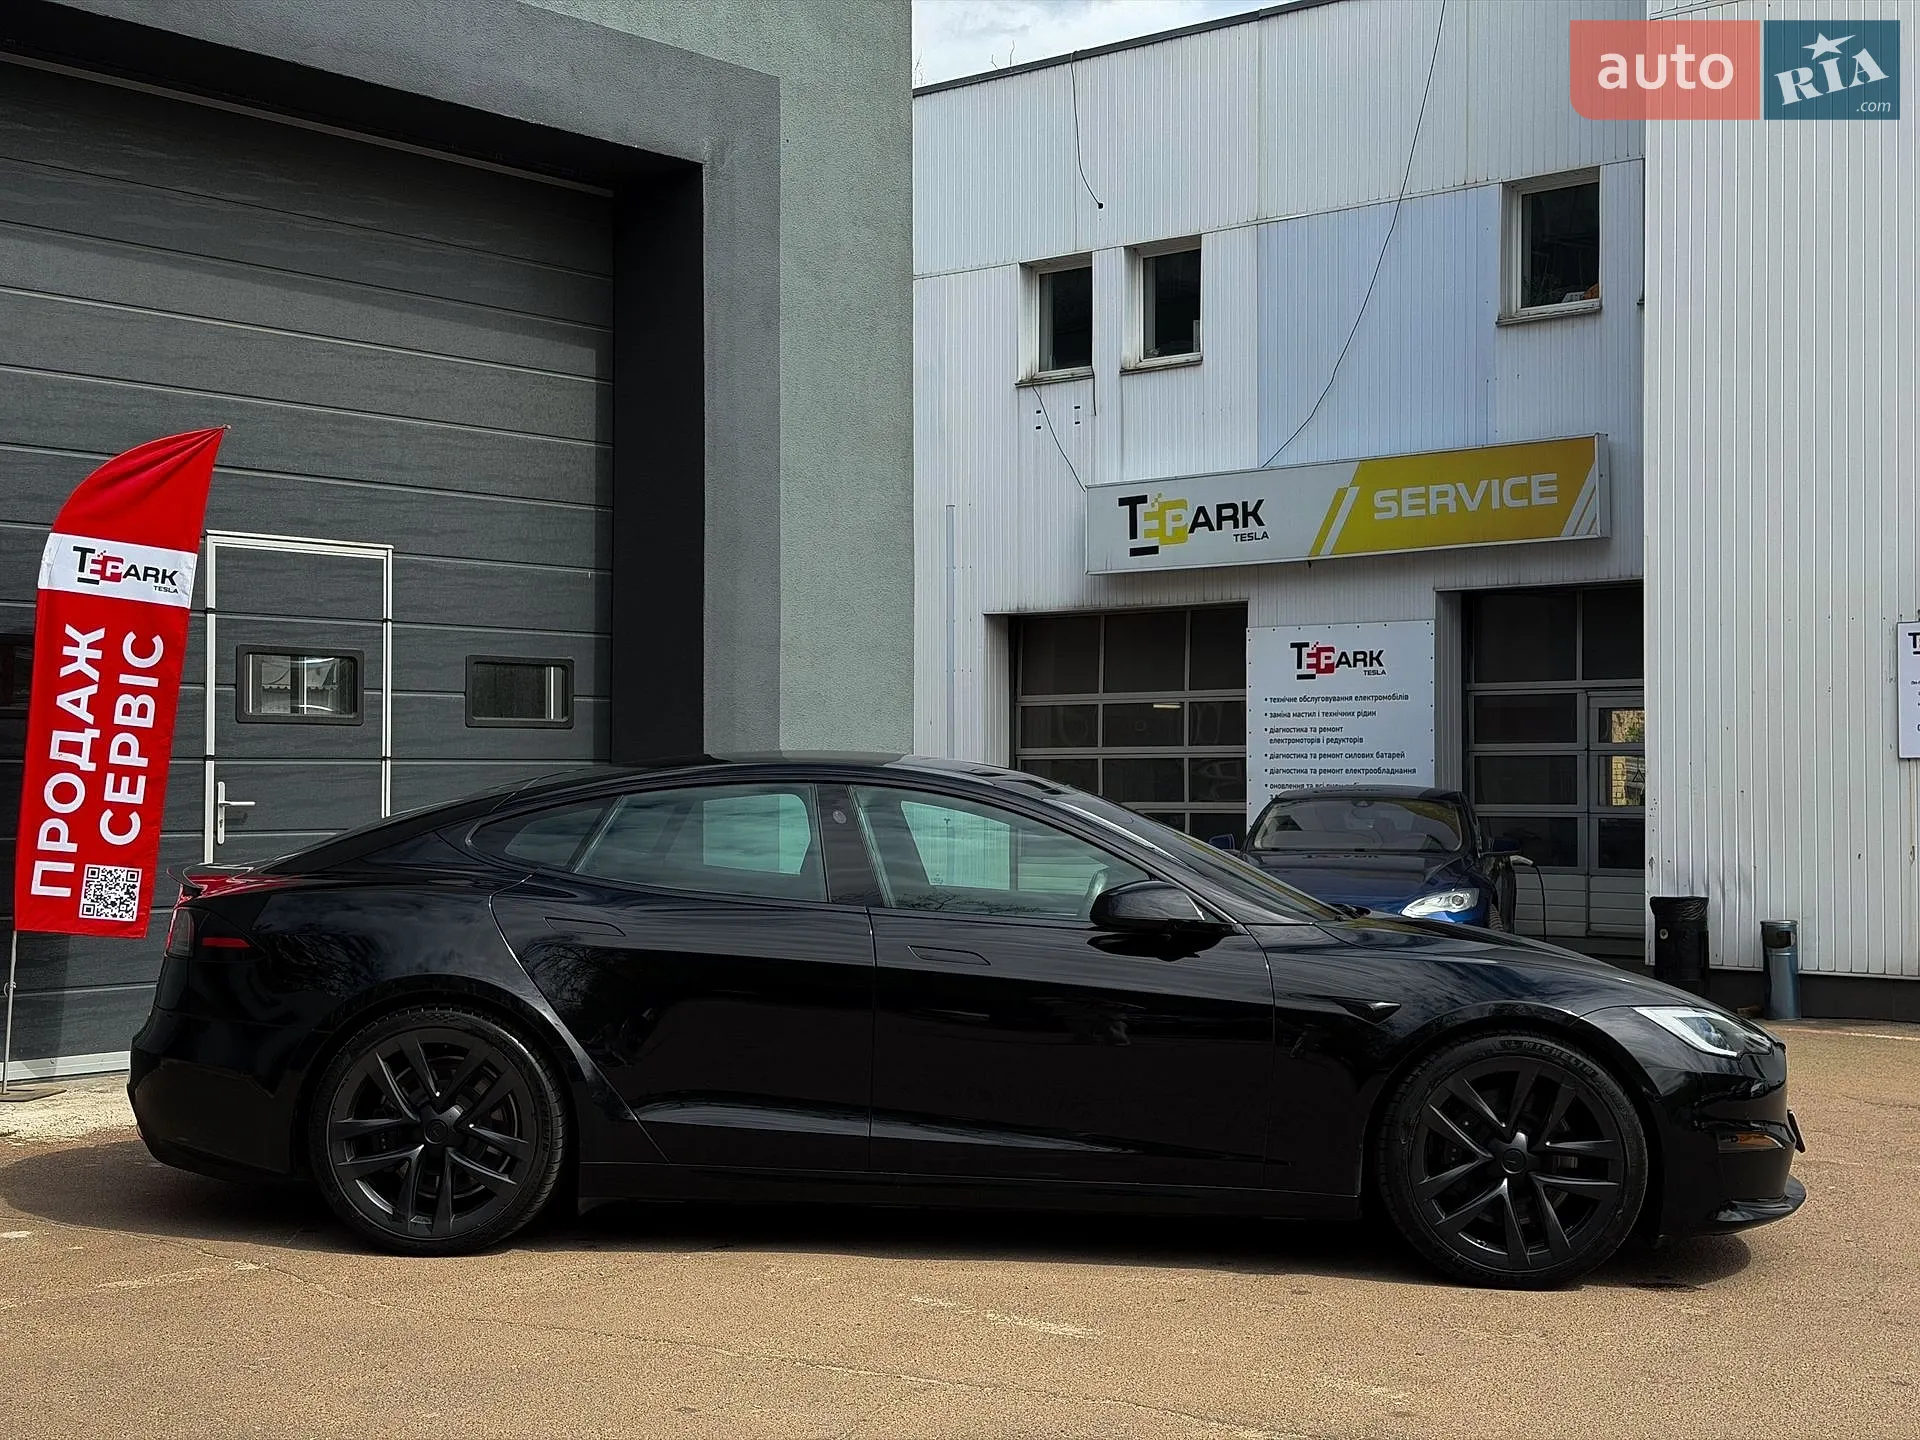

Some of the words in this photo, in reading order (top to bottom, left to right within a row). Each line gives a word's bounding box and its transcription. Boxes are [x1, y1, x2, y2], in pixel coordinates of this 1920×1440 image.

[1373, 472, 1558, 520] SERVICE
[1233, 530, 1269, 543] TESLA
[153, 585, 179, 594] TESLA
[1299, 694, 1353, 704] обслуговування
[1355, 692, 1409, 703] електромобілів
[1269, 710, 1291, 718] заміна
[1322, 709, 1355, 718] технічних
[1357, 708, 1377, 719] рідин
[1269, 725, 1308, 734] діагностика
[1319, 726, 1343, 734] ремонт
[99, 631, 164, 846] СЕРВІС
[1269, 735, 1321, 746] електромоторів
[1326, 736, 1364, 746] редукторів
[31, 623, 106, 897] ПРОДАЖ
[1269, 752, 1308, 760] діагностика
[1319, 752, 1343, 760] ремонт
[1375, 750, 1405, 760] батарей
[1269, 767, 1308, 775] діагностика
[1319, 768, 1343, 776] ремонт
[1344, 766, 1417, 776] електрообладнання
